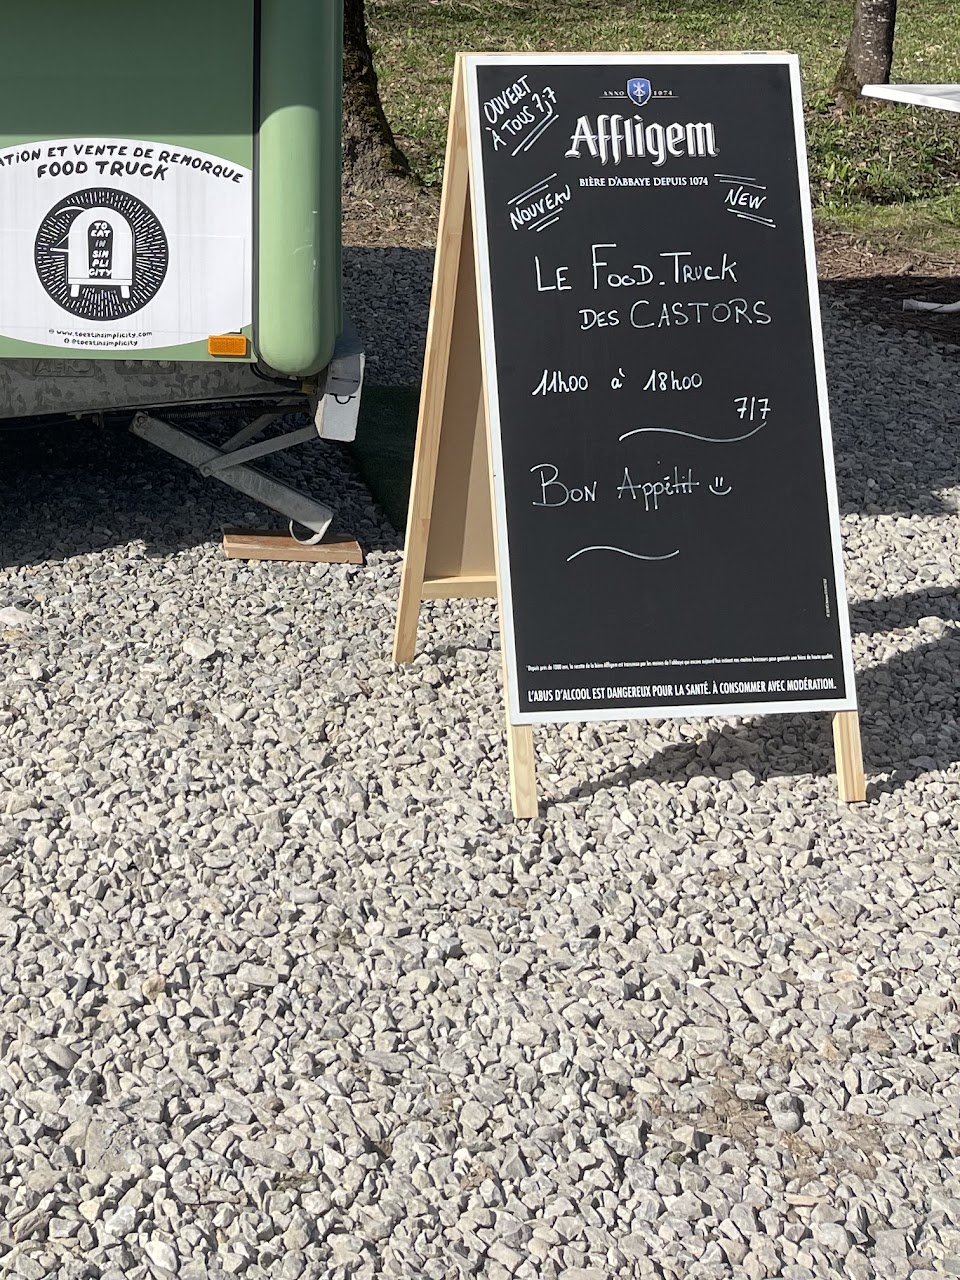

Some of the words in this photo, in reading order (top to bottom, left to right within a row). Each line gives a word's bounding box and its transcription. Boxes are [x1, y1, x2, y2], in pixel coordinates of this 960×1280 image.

[484, 74, 531, 124] OUVERT
[485, 127, 507, 151] À
[500, 105, 535, 135] TOUS
[564, 114, 719, 167] Affligem
[37, 160, 88, 179] FOOD
[95, 160, 169, 181] TRUCK
[48, 146, 68, 158] ET
[74, 144, 128, 156] VENTE
[134, 147, 154, 159] DE
[159, 150, 243, 183] REMORQUE
[579, 176, 606, 187] BIÈRE
[608, 176, 650, 187] D'ABBAYE
[653, 177, 687, 186] DEPUIS
[689, 177, 708, 186] 1074
[510, 184, 571, 230] NOUVEAU
[725, 186, 766, 209] NEW
[90, 229, 111, 237] EAT
[94, 222, 108, 230] TO
[92, 250, 109, 258] SIM
[95, 240, 107, 248] IN
[89, 268, 112, 277] CITY
[92, 259, 109, 267] PLI
[535, 255, 572, 291] LE
[579, 309, 620, 330] DES
[630, 298, 772, 329] CASTORS
[56, 329, 153, 339] www.toeatinsimplicity.com
[531, 369, 589, 396] 11h00
[610, 367, 626, 390] à
[643, 369, 703, 391] 18h00
[734, 397, 771, 421] 7/7
[617, 466, 700, 511] Appétit
[528, 690, 553, 702] L'ABUS
[555, 688, 591, 701] D'ALCOOL
[592, 688, 606, 700] EST
[607, 686, 651, 699] DANGEREUX
[652, 685, 674, 697] POUR
[675, 684, 684, 696] LA
[685, 681, 711, 696] SANTÉ.
[712, 681, 718, 694] À
[720, 681, 766, 694] CONSOMMER
[768, 679, 786, 692] AVEC
[787, 677, 837, 691] MODÉRATION.
